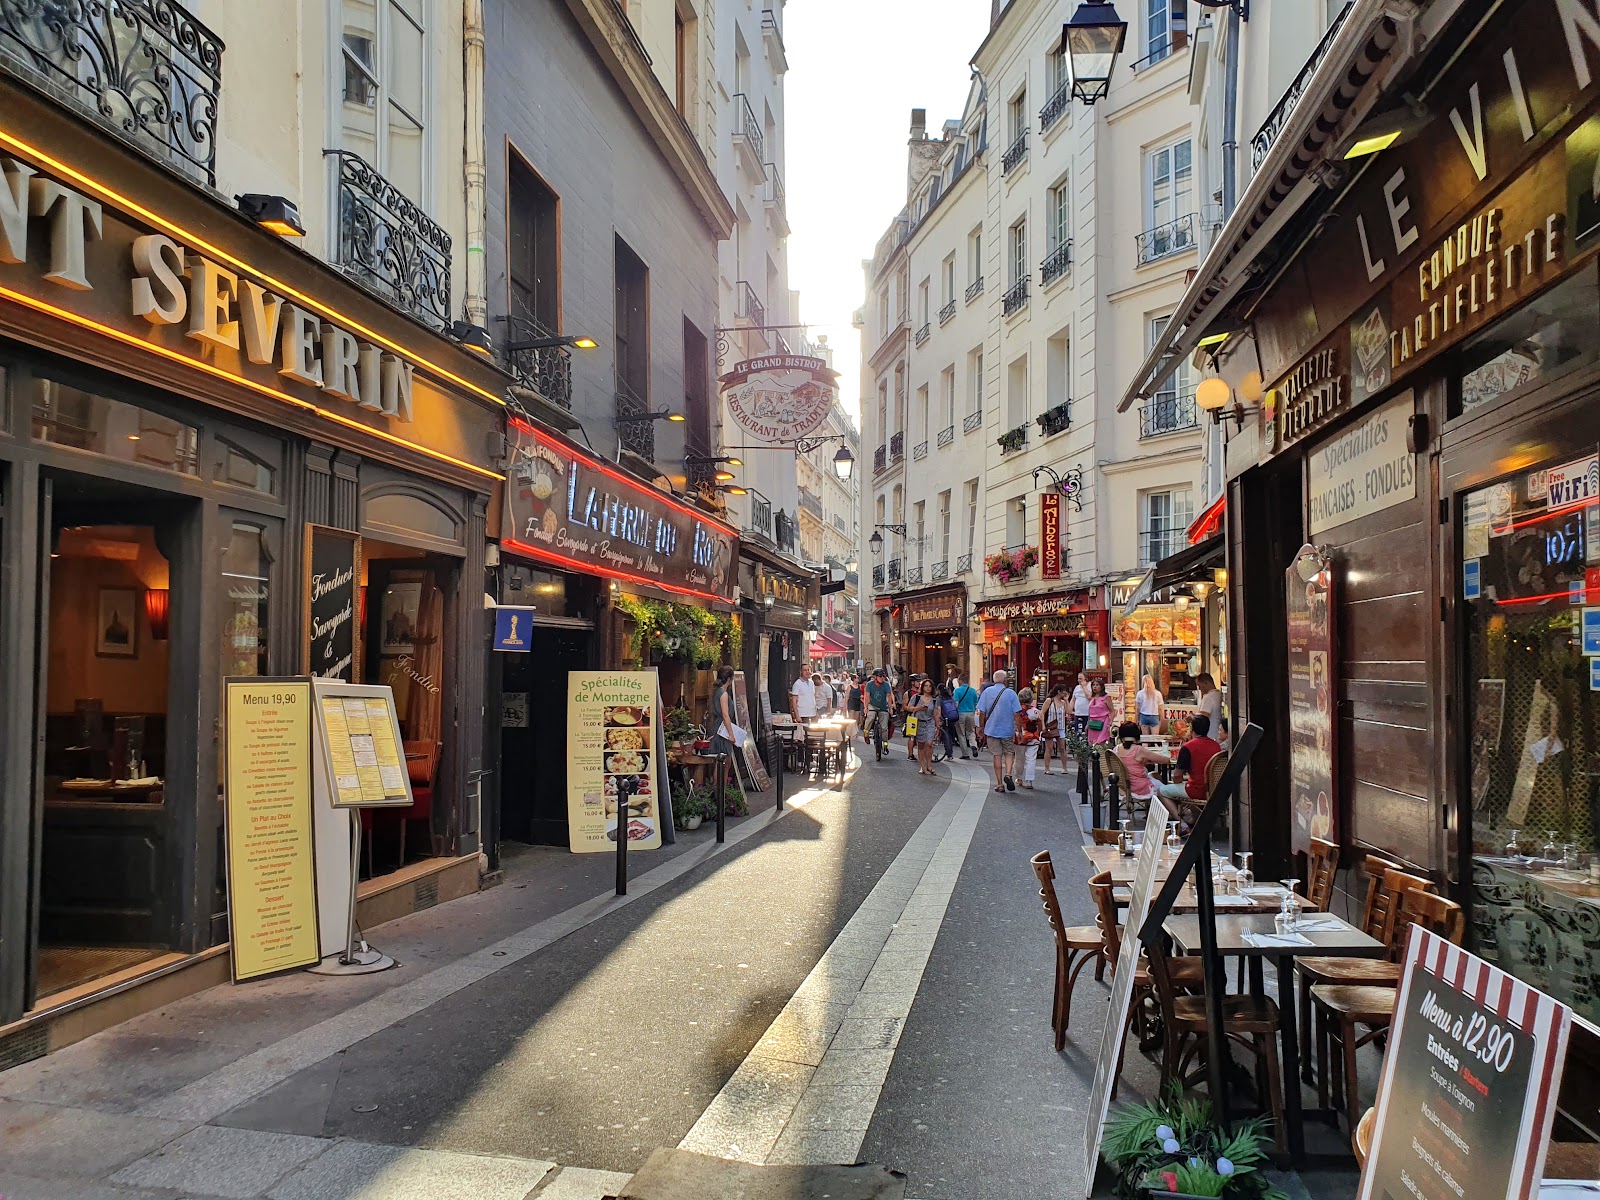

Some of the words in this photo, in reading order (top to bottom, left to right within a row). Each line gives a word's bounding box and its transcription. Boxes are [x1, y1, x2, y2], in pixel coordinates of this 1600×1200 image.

[1356, 166, 1418, 283] LE
[1419, 207, 1497, 302] FONDUE
[1390, 212, 1557, 369] TARTIFLETTE
[132, 234, 414, 424] SEVERIN
[737, 364, 748, 374] LE
[751, 358, 781, 370] GRAND
[785, 358, 822, 370] BISTROT
[1284, 348, 1333, 409] RACLETTE
[728, 393, 778, 438] RESTAURANT
[781, 426, 789, 437] de
[792, 388, 832, 434] TRADITION
[1282, 376, 1342, 440] PIERRADE
[540, 446, 565, 476] FONDUE
[1324, 413, 1388, 479] Spécialités
[1366, 452, 1413, 502] FONDUES
[1550, 471, 1564, 484] Free
[1550, 474, 1588, 505] WiFi
[312, 566, 353, 602] Fondues
[324, 641, 333, 659] &
[392, 654, 440, 695] Fondue
[581, 676, 642, 691] Spécialités
[243, 694, 269, 704] Menu
[272, 694, 296, 705] 19,90
[575, 692, 588, 702] de
[592, 692, 650, 705] Montagne
[1419, 990, 1451, 1032] Menu
[1451, 1010, 1463, 1042] à
[1462, 1011, 1515, 1073] 12,90
[1427, 1034, 1459, 1072] Entrées
[1430, 1066, 1447, 1088] Soupe
[1447, 1080, 1452, 1093] à
[1452, 1083, 1475, 1112] l'oignon
[1421, 1101, 1440, 1128] Moules
[1412, 1136, 1434, 1167] Beignets
[1434, 1160, 1442, 1175] de
[1400, 1169, 1418, 1198] Salade
